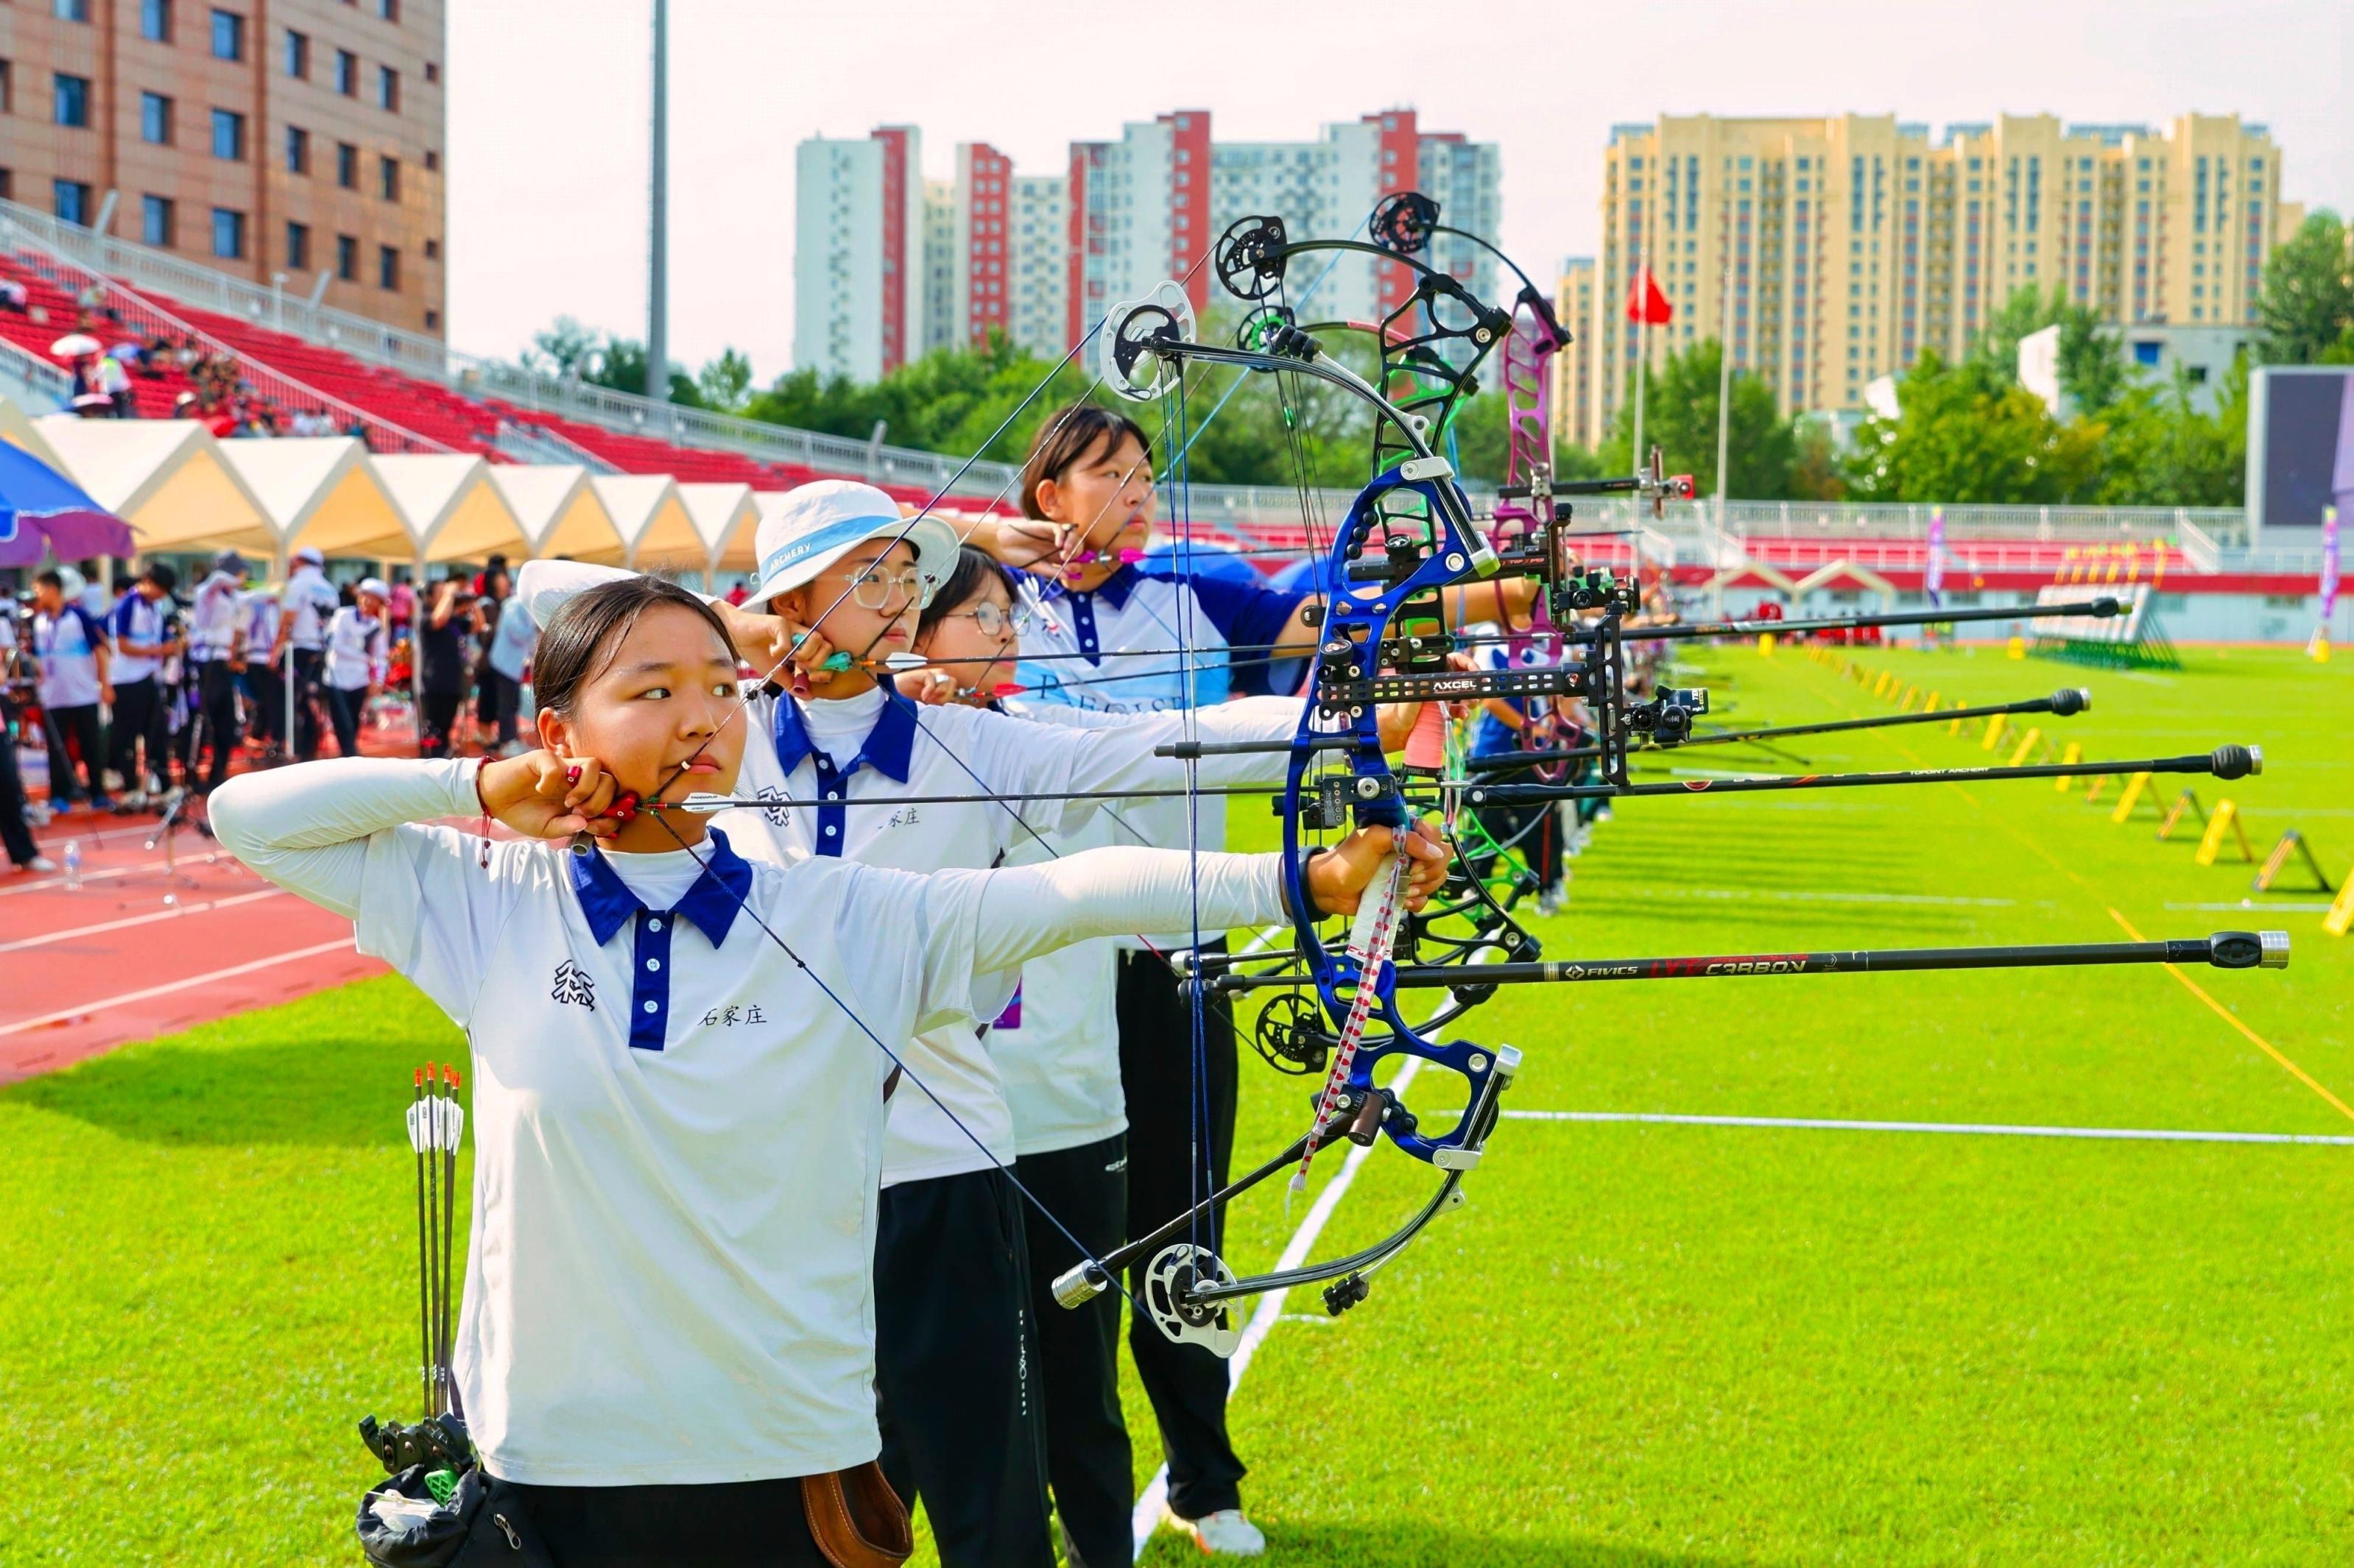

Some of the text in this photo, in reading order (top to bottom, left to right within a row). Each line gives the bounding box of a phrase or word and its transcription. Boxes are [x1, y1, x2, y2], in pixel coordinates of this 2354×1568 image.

[769, 542, 811, 572] ARCHERY
[1433, 680, 1477, 691] AXCEL
[1587, 966, 1639, 977] FIVICS
[1705, 960, 1807, 976] CARBON
[697, 1004, 767, 1027] 石家庄
